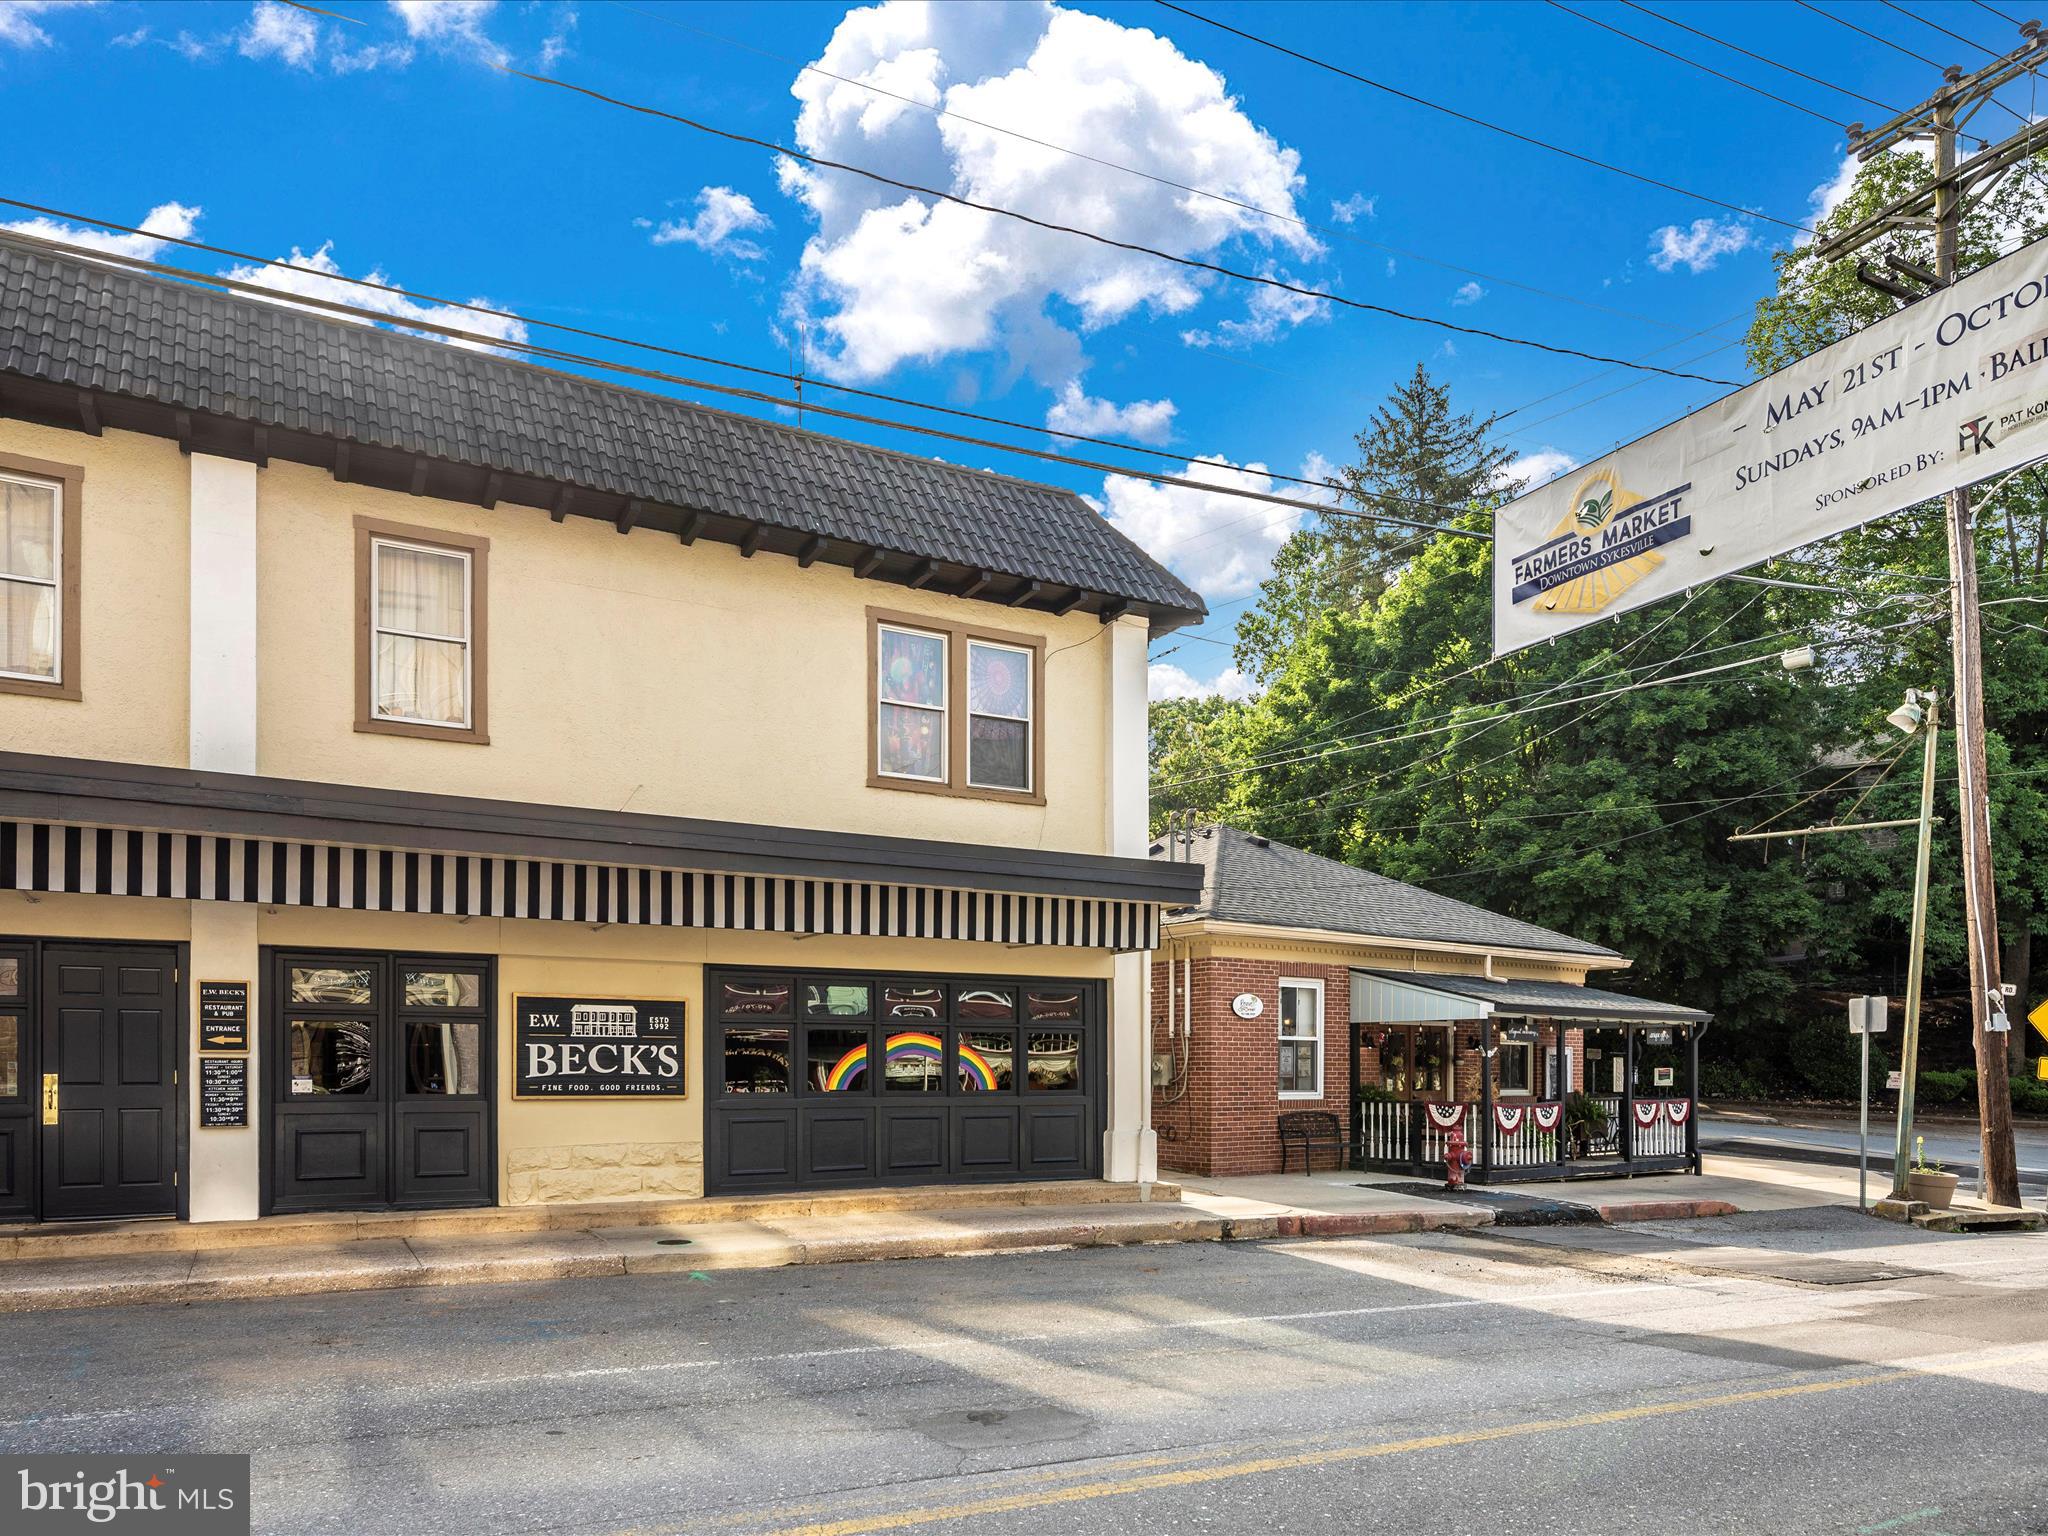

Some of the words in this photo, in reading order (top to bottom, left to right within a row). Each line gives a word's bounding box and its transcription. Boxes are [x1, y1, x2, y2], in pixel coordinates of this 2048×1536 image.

[1765, 380, 1829, 430] MAY
[1843, 346, 1903, 393] 21ST
[2001, 410, 2023, 427] PAT
[1736, 429, 1845, 491] SUNDAYS,
[1815, 463, 1911, 511] SPONSORED
[1917, 450, 1944, 473] BY:
[1515, 536, 1592, 584] FARMERS
[1601, 497, 1682, 549] MARKET
[1539, 557, 1598, 591] DOWNTOWN
[1600, 535, 1655, 567] SYKESVILLE
[529, 1013, 560, 1028] E.W.
[525, 1043, 679, 1079] BECK'S
